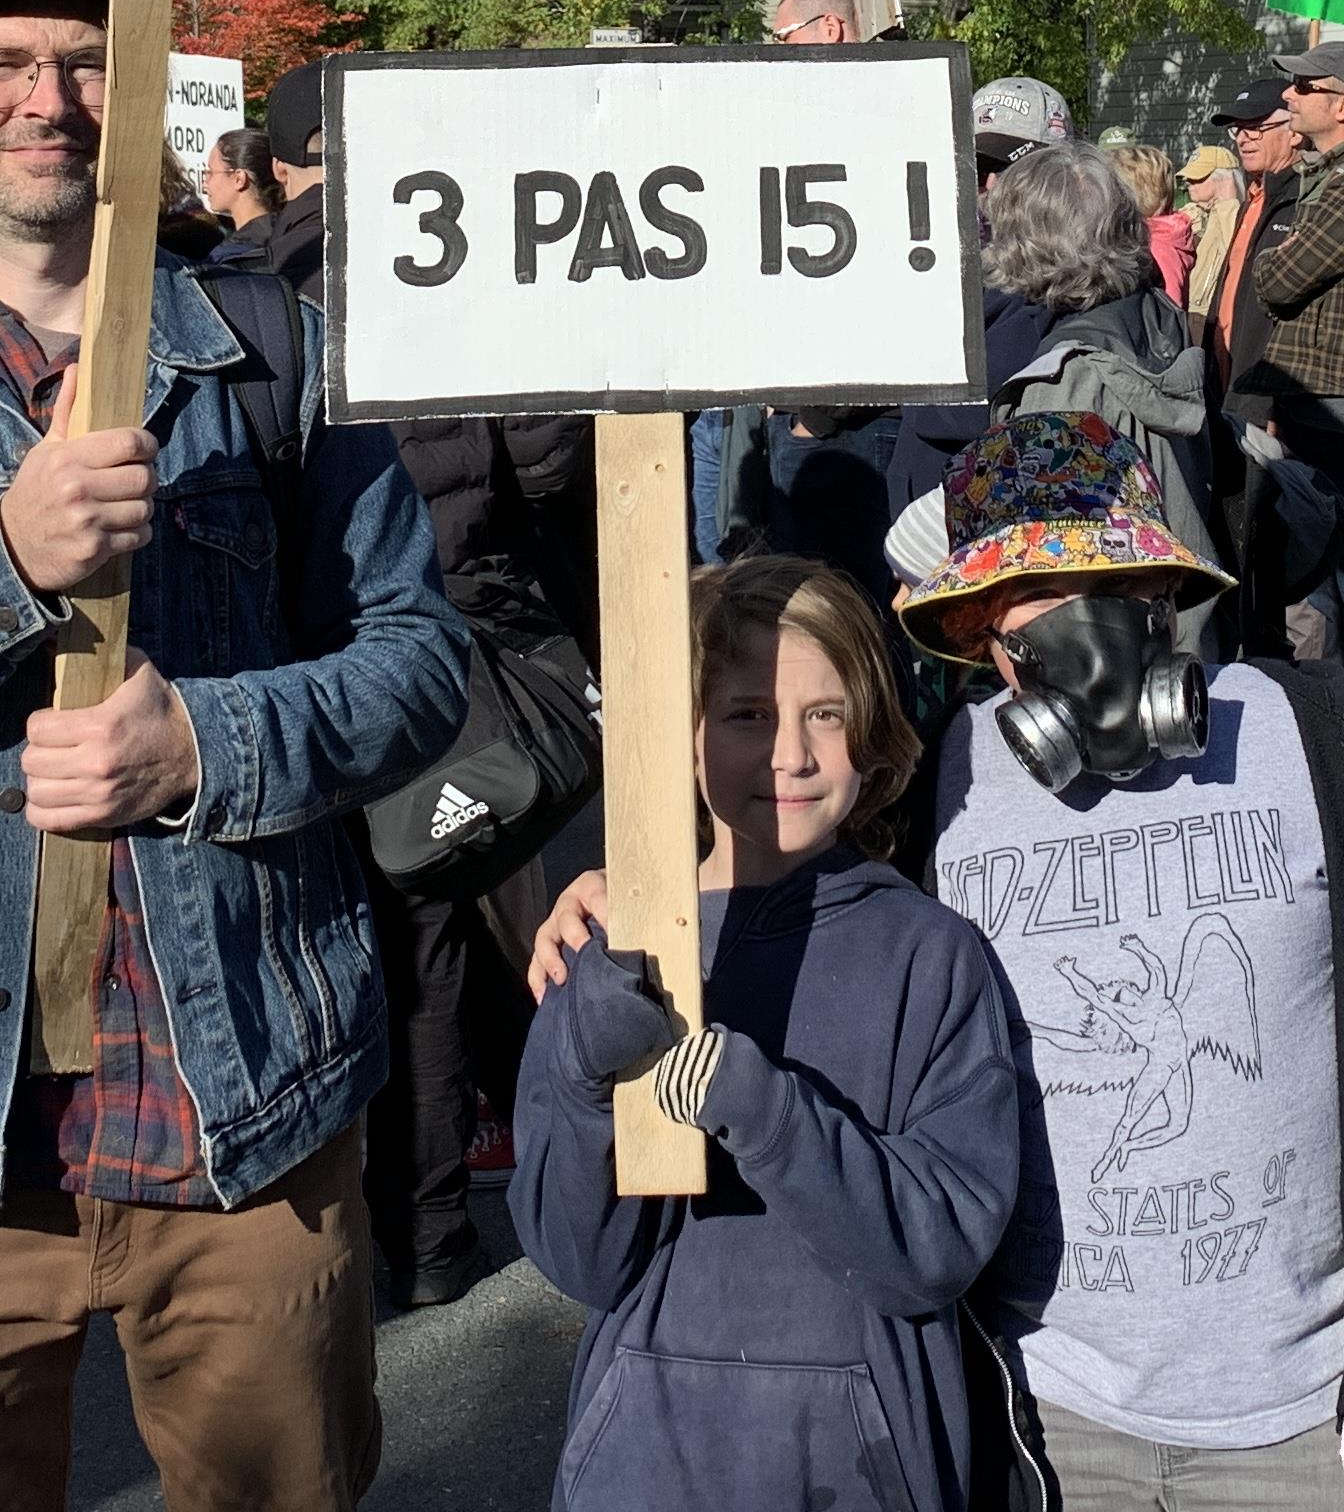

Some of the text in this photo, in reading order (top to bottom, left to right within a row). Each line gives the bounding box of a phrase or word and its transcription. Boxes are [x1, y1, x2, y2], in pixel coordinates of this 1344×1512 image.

[596, 34, 636, 43] MAXIMUM
[393, 161, 936, 287] 3 PAS 15 !
[430, 801, 490, 839] adidas
[1086, 1170, 1235, 1237] STATES
[1261, 1147, 1296, 1208] OF
[1180, 1217, 1268, 1286] 1977
